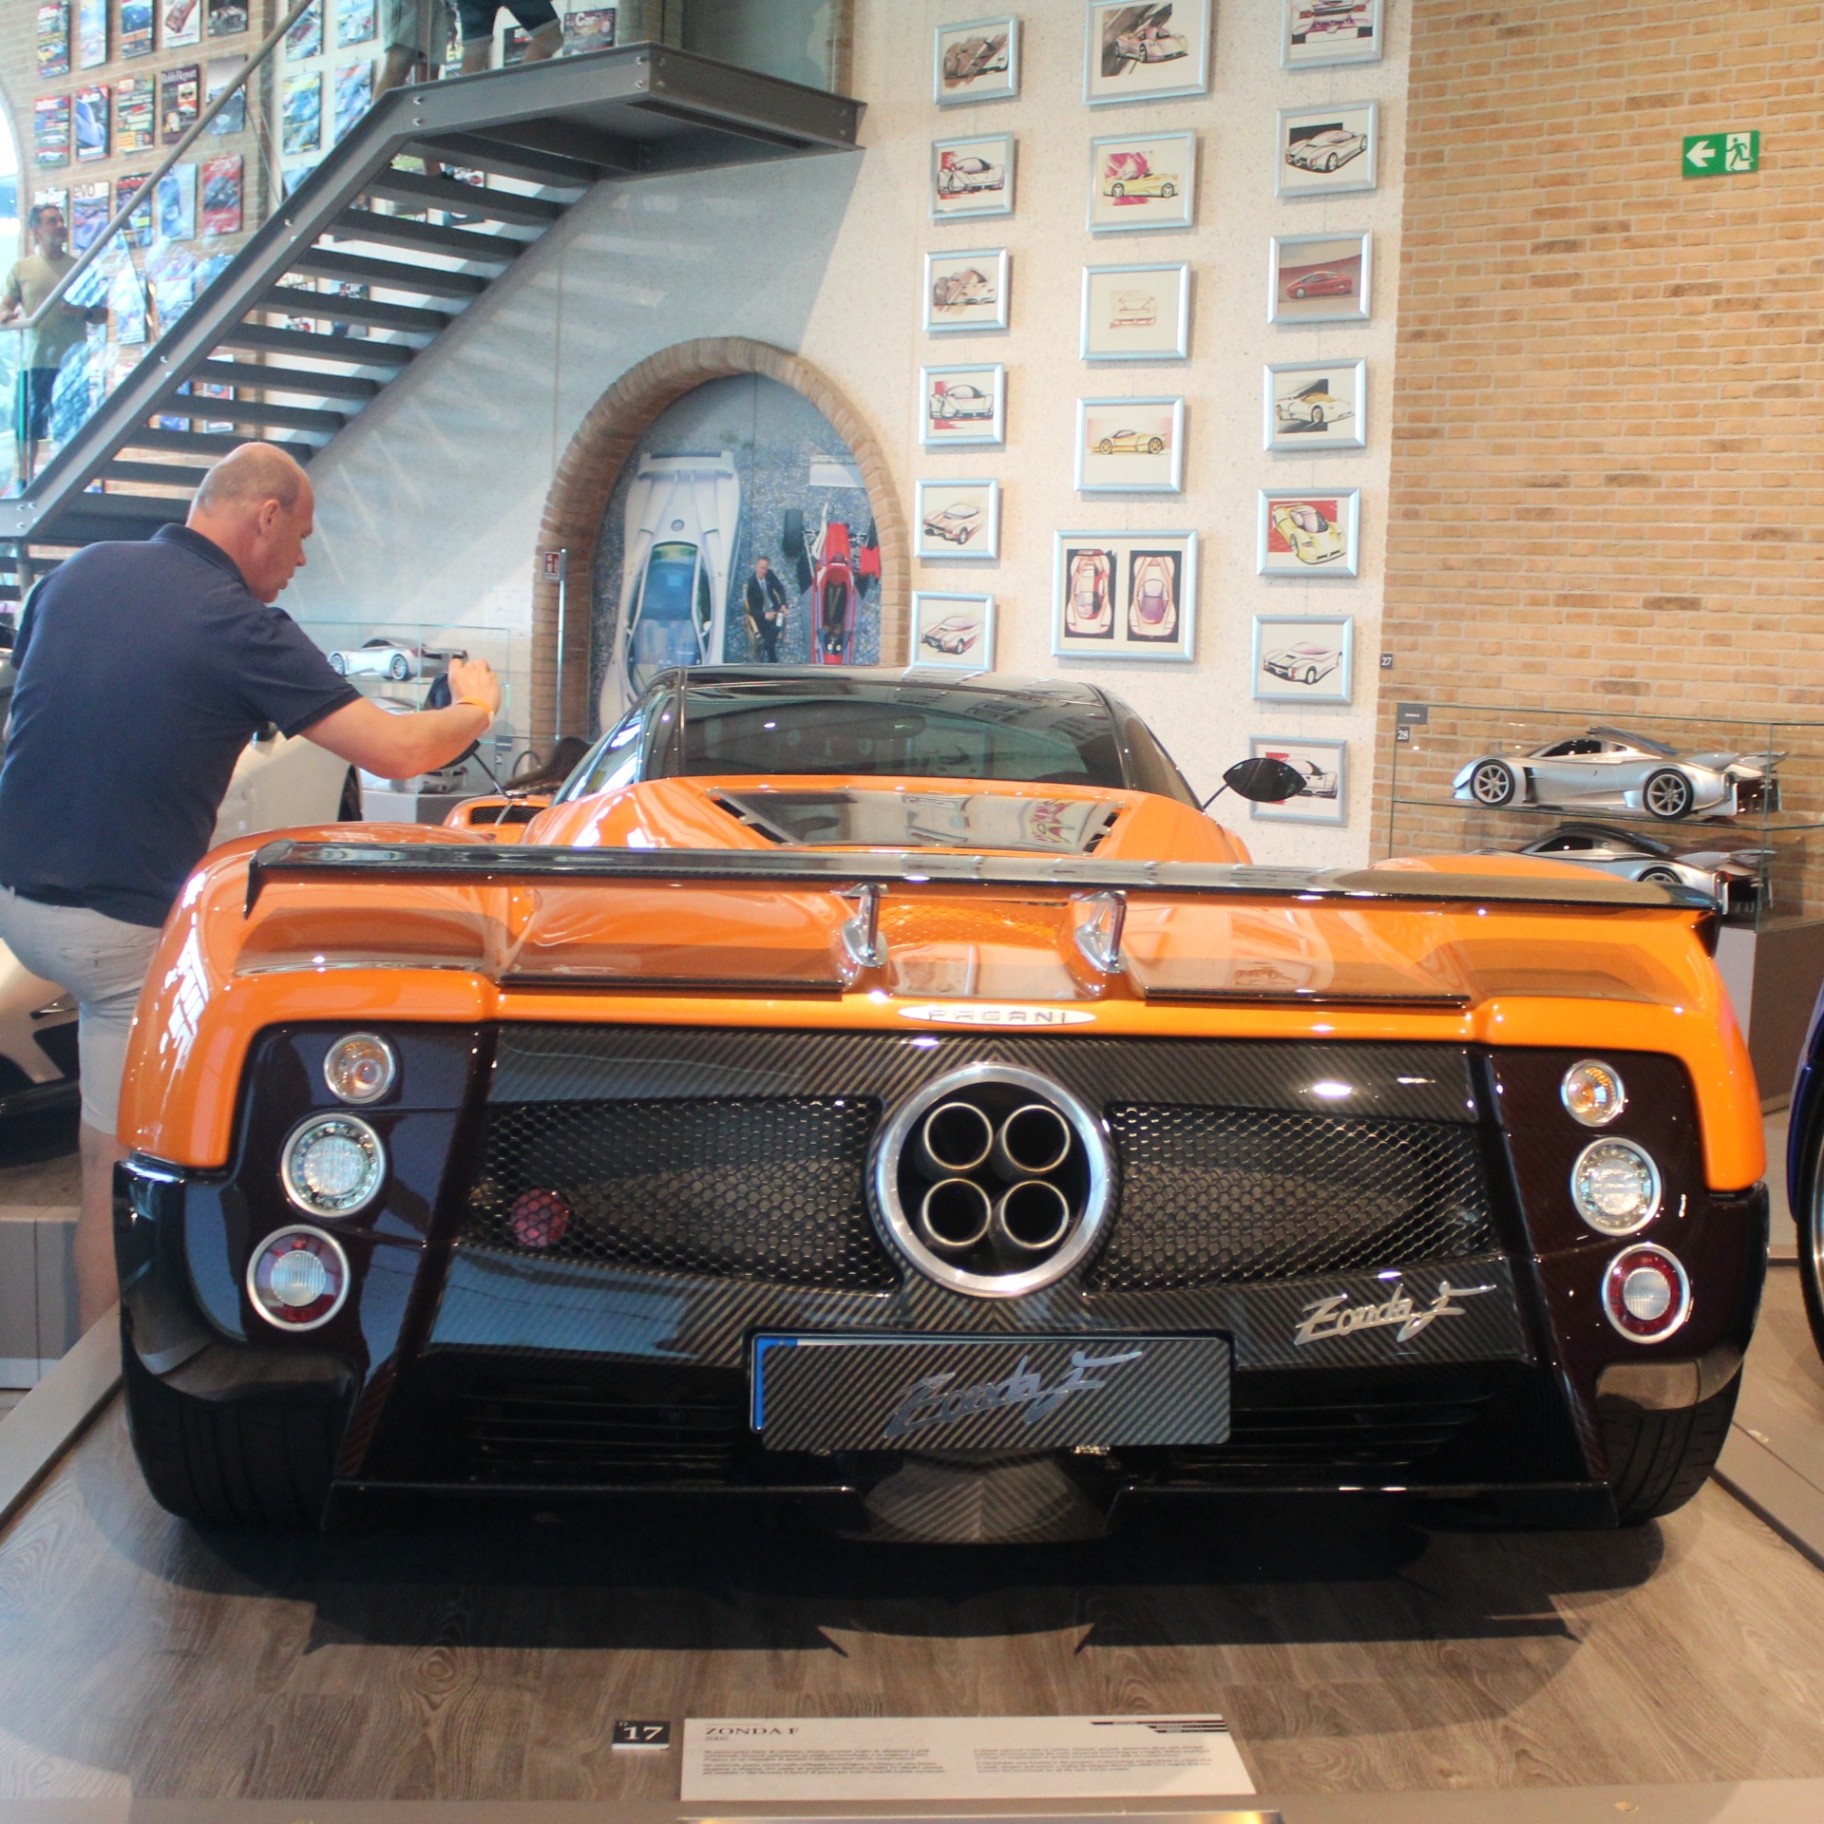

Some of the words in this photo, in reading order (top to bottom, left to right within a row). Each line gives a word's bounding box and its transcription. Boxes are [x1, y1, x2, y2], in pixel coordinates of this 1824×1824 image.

[1381, 656, 1392, 666] 27
[1397, 730, 1409, 740] 28
[927, 1009, 1067, 1024] PAGANI
[1294, 1284, 1416, 1346] Zonda
[884, 1354, 1042, 1439] Zonda
[623, 1725, 664, 1742] 17
[705, 1726, 783, 1736] ZONDA
[788, 1726, 799, 1736] F
